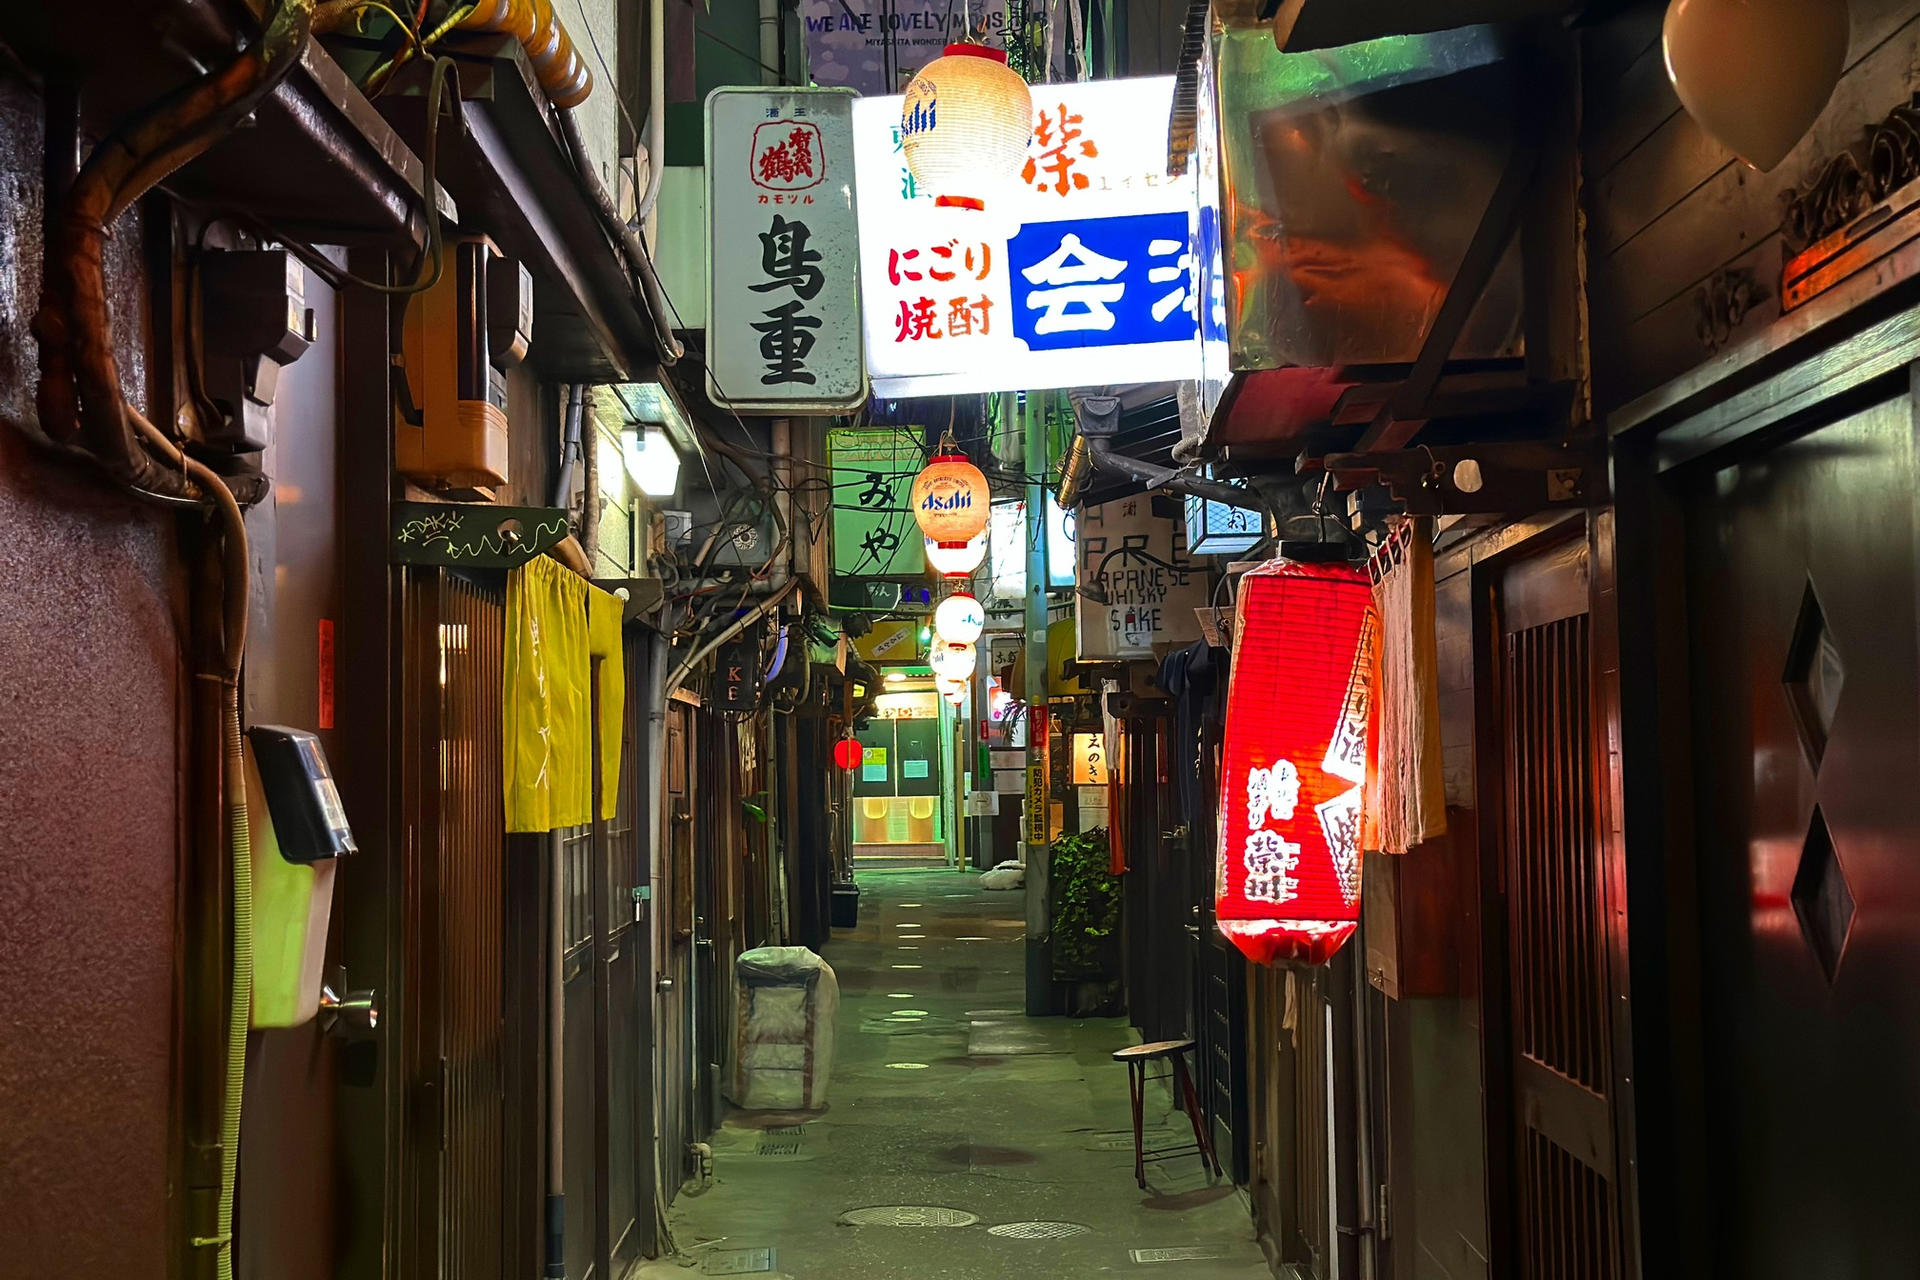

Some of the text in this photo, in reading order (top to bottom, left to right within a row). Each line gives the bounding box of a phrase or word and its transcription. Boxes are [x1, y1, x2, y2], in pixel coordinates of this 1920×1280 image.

[806, 16, 833, 32] WE
[840, 13, 872, 34] ARE
[879, 11, 947, 33] LOVELY
[758, 195, 814, 205] カモツル
[888, 238, 991, 286] にごり
[748, 213, 826, 385] 鳥重
[895, 293, 994, 343] 焼酎
[859, 473, 899, 563] みや
[921, 490, 972, 510] Asahi
[1110, 606, 1163, 632] SAKE
[1087, 733, 1101, 784] えのき
